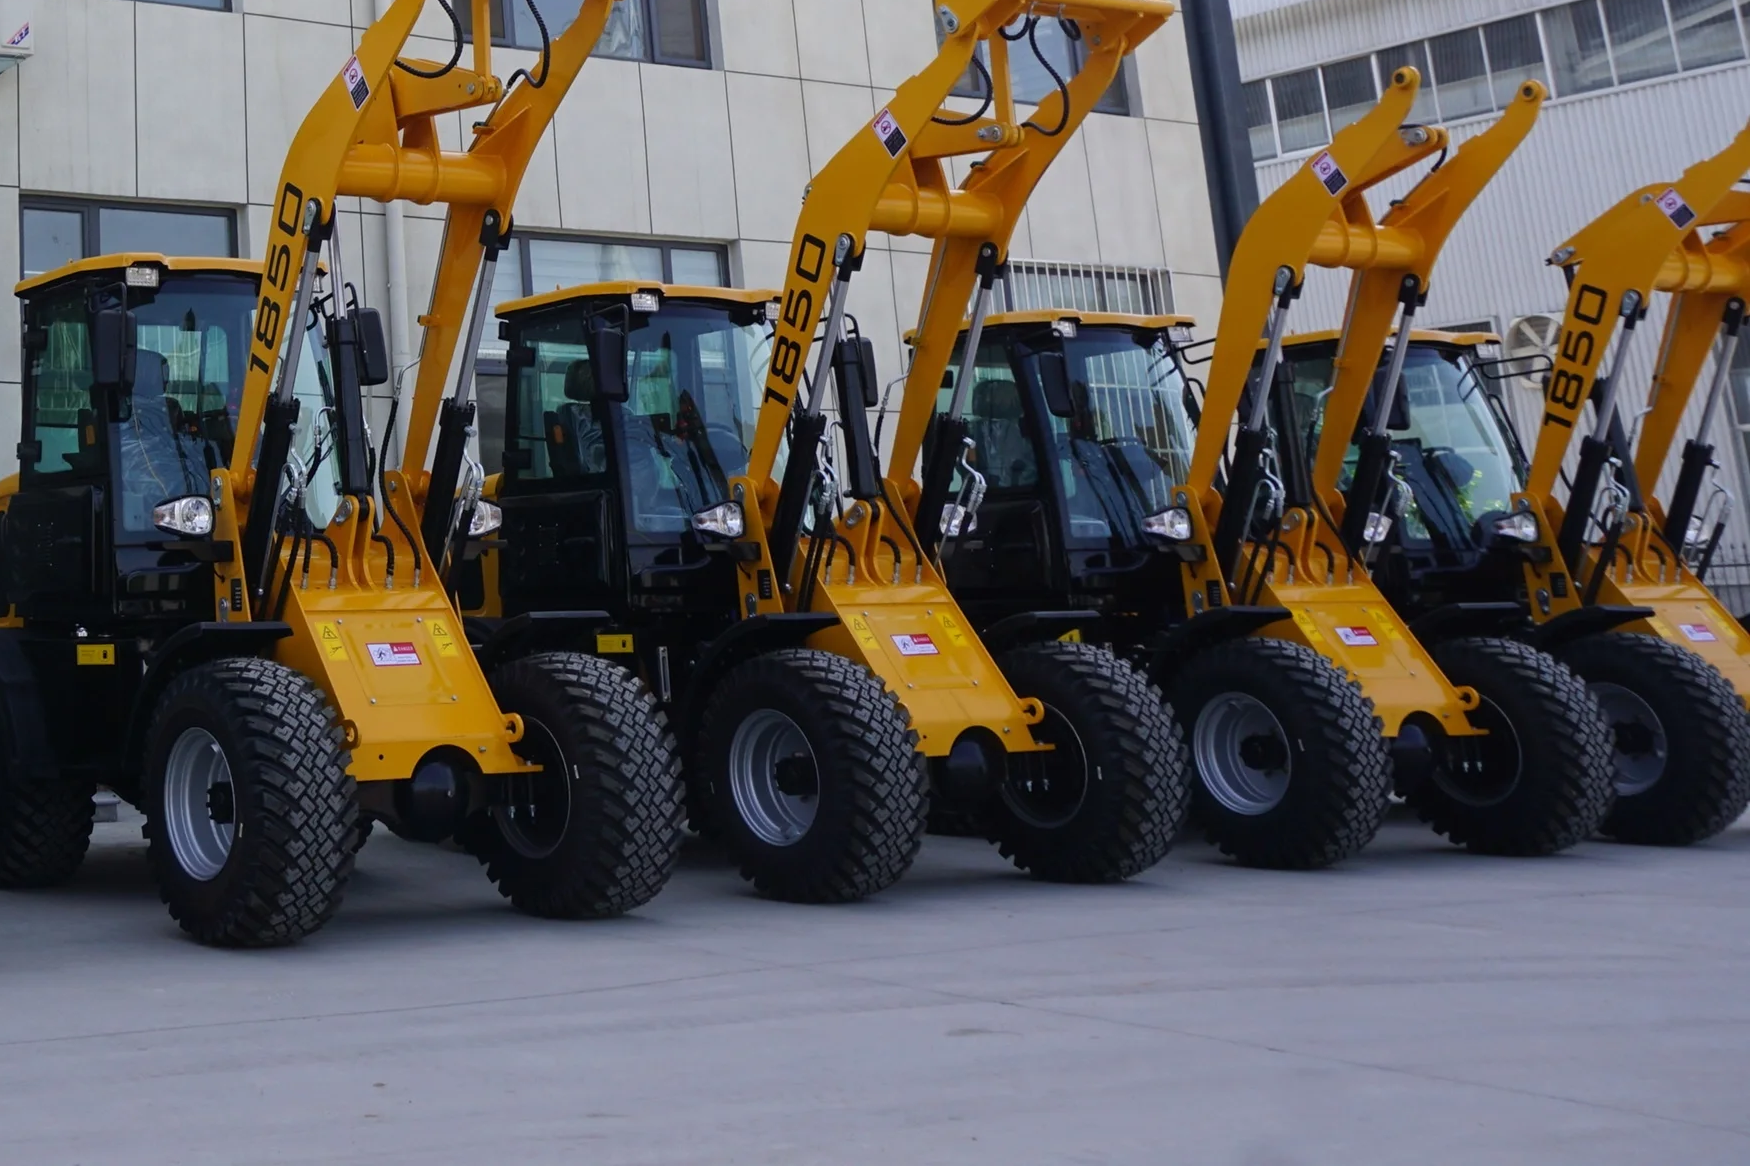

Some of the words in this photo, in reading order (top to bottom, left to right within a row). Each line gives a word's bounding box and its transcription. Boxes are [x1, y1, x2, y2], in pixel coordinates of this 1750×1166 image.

[250, 182, 303, 375] 1850
[764, 233, 826, 407] 1850
[1544, 284, 1607, 428] 1850
